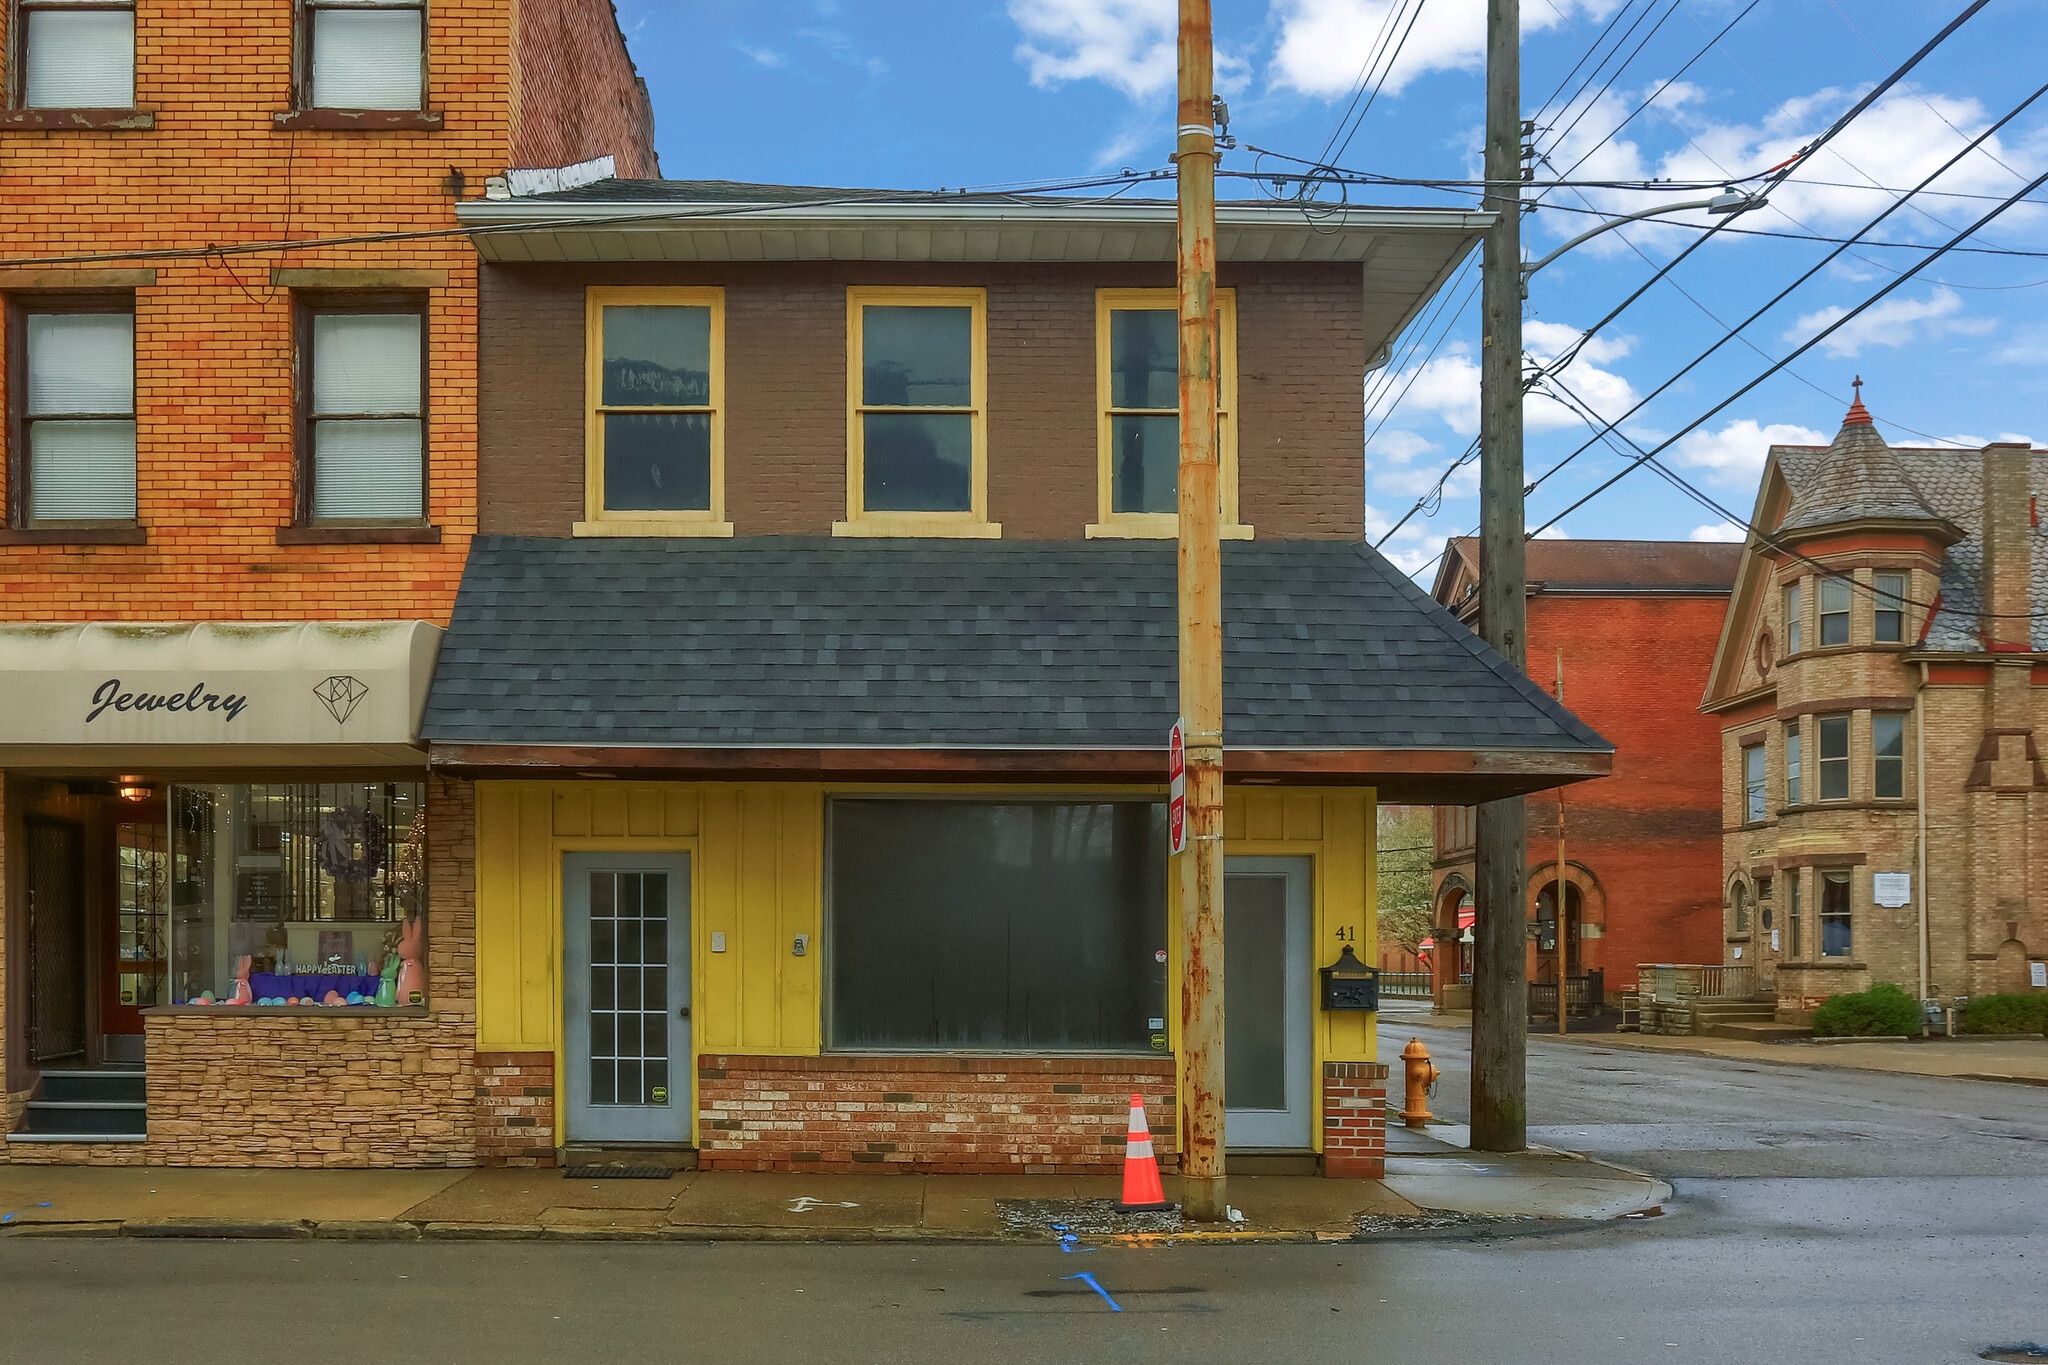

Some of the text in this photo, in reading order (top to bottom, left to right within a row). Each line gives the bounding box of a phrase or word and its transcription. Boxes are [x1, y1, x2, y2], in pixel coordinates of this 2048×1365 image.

[86, 679, 248, 723] Jewelry
[1335, 925, 1355, 941] 41
[296, 964, 323, 974] HAPPY
